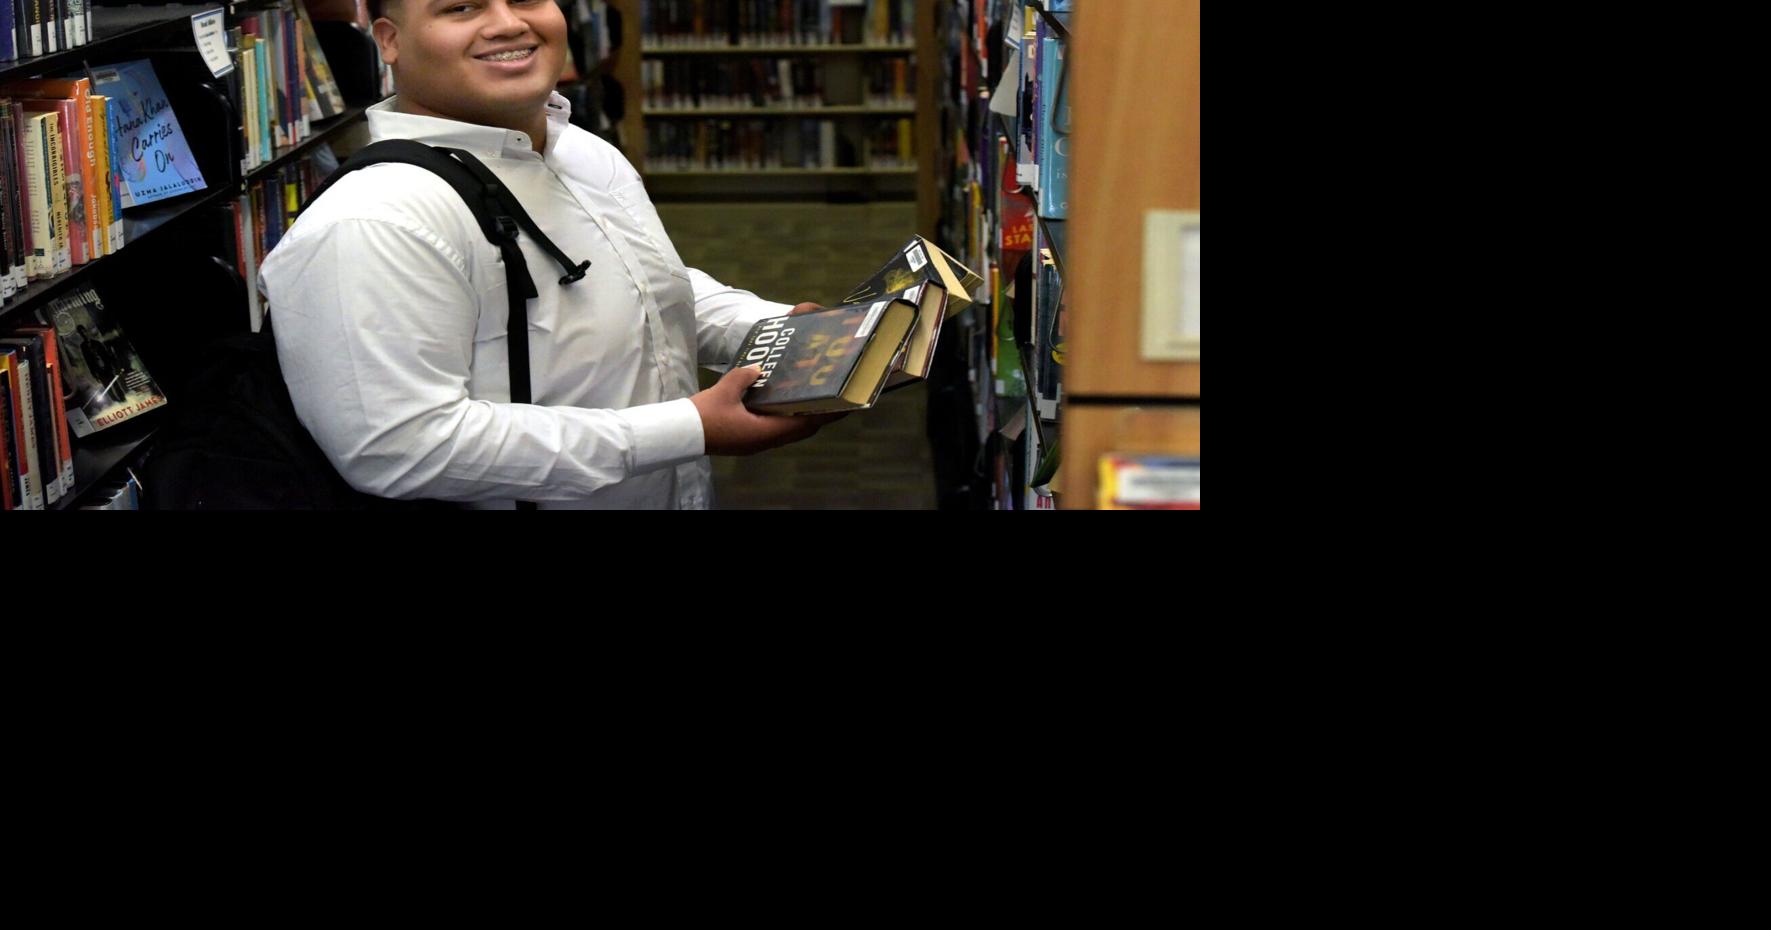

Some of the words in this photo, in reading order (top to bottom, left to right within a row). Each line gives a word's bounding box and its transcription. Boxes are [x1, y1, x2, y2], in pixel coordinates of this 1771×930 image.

[140, 99, 169, 124] Khan
[86, 117, 96, 167] Enough
[131, 122, 174, 162] Carries
[154, 149, 175, 173] On
[134, 188, 157, 198] UZMA
[752, 327, 796, 388] COLLEEN
[96, 406, 133, 427] ELLIOTT
[135, 395, 162, 412] JAMES
